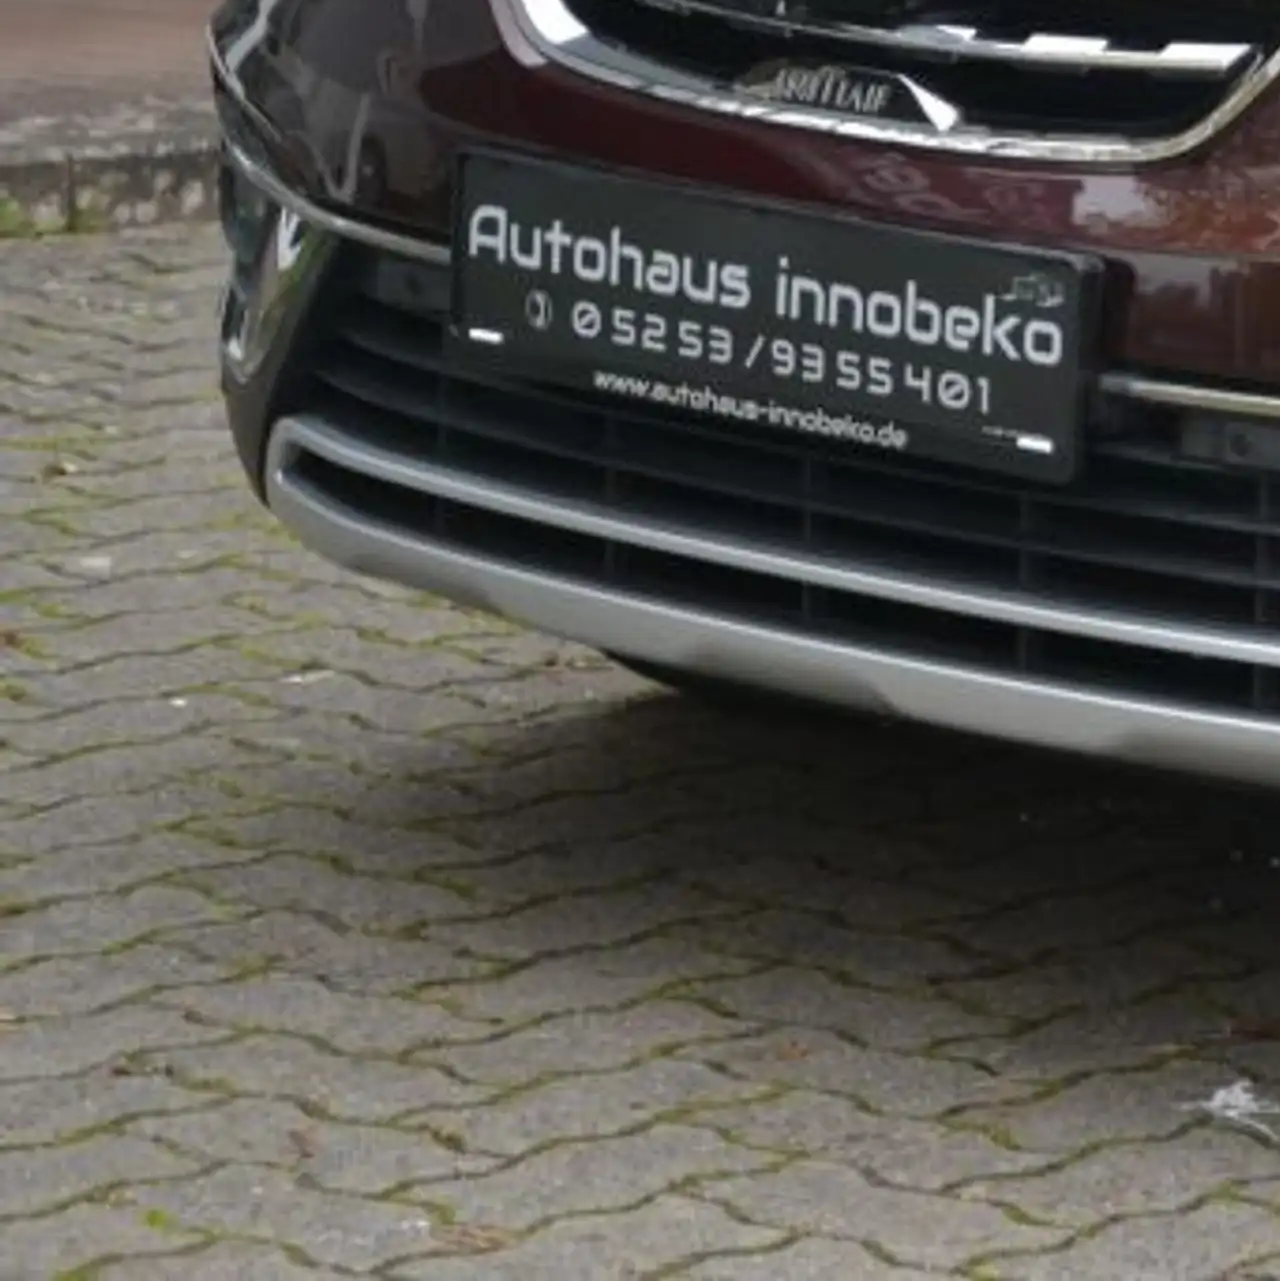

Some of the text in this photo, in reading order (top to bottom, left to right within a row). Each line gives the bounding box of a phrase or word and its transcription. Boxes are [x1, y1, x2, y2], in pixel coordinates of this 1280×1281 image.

[468, 204, 1063, 366] Autohaus innobeko
[593, 370, 909, 451] www.autohaus-innobeko.de
